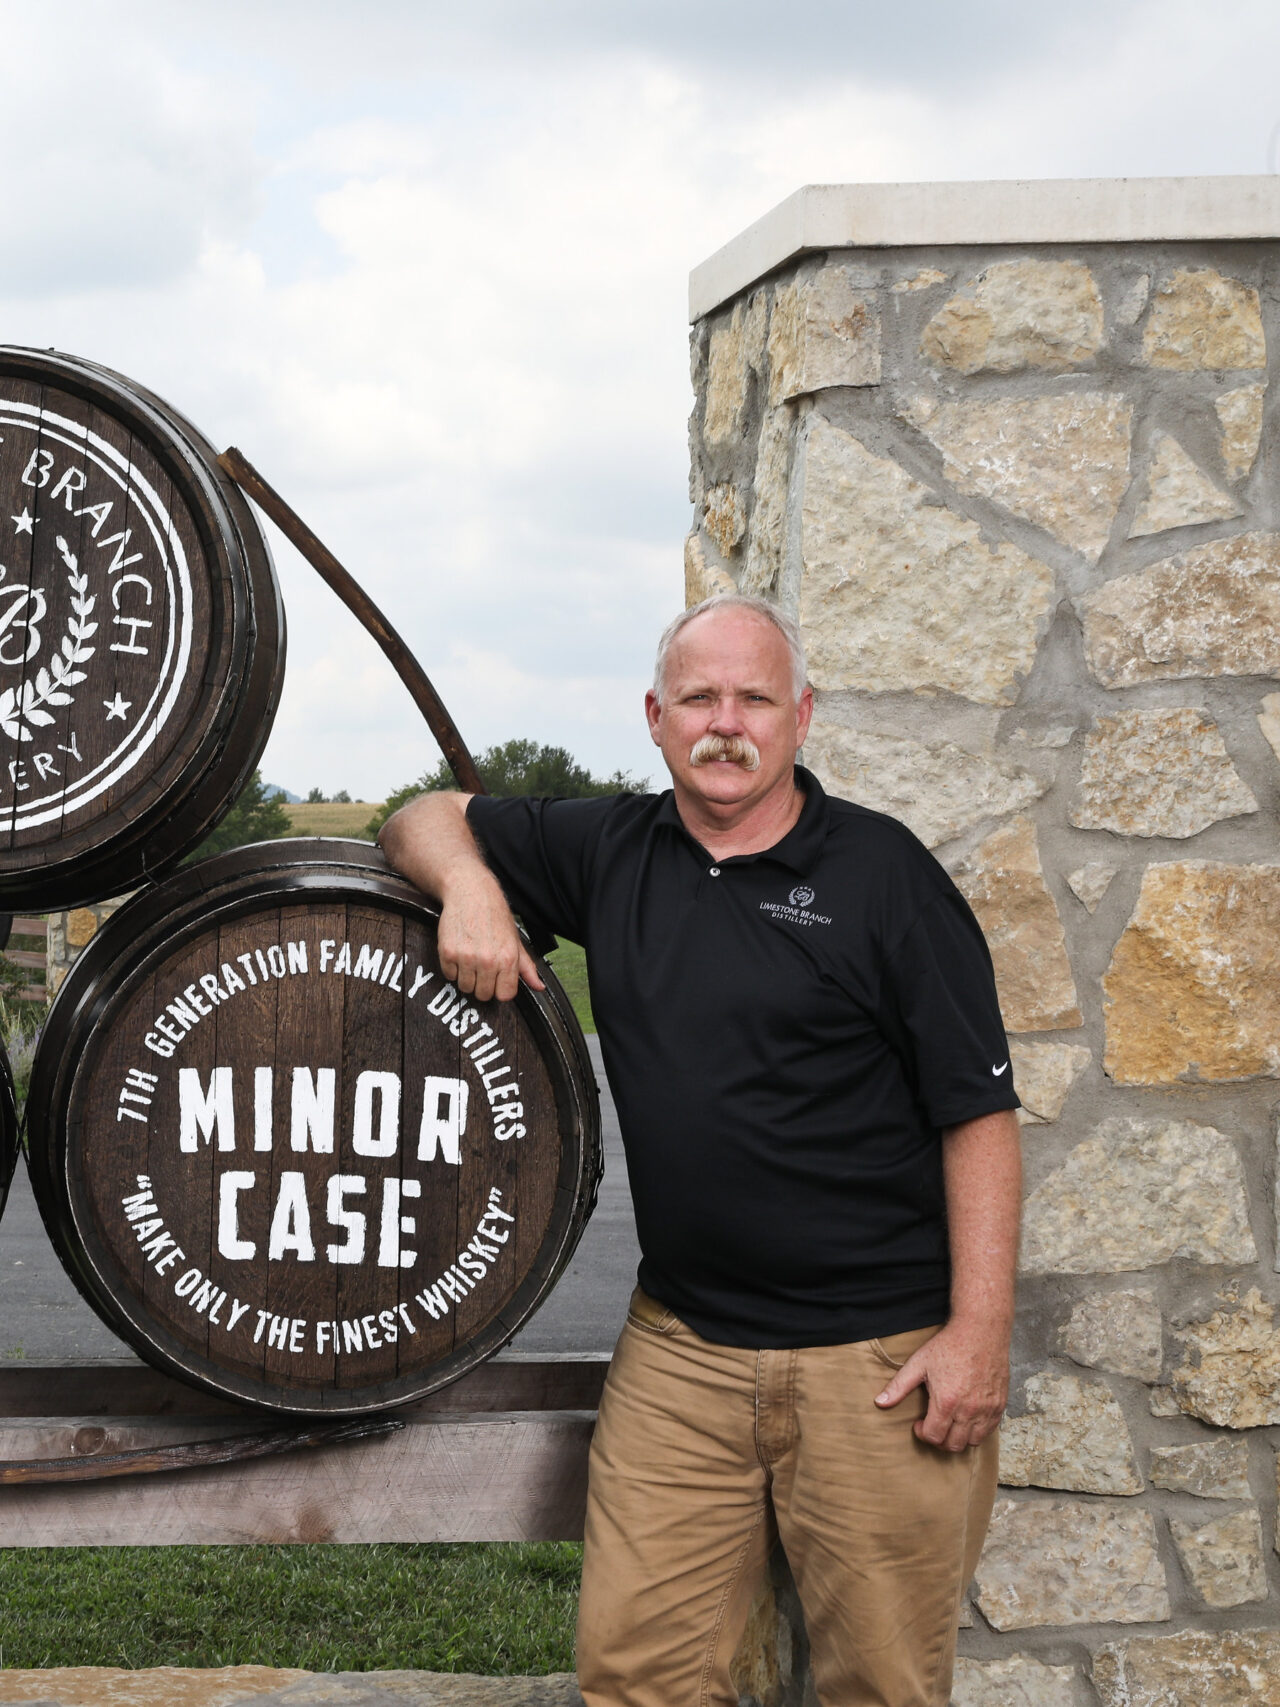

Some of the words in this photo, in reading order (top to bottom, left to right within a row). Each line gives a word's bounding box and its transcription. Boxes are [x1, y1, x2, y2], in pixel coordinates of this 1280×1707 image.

[21, 448, 153, 655] BRANCH
[759, 901, 799, 916] LIMESTONE
[800, 910, 832, 925] BRANCH
[771, 911, 813, 927] DISTILLERY
[117, 1067, 158, 1122] 7TH
[145, 940, 308, 1058] GENERATION
[319, 939, 434, 1000] FAMILY
[426, 983, 526, 1142] DISTILLERS
[178, 1066, 470, 1165] MINOR
[217, 1170, 421, 1268] CASE
[174, 1266, 249, 1332] ONLY
[253, 1308, 306, 1353] THE
[316, 1303, 417, 1355] FINEST
